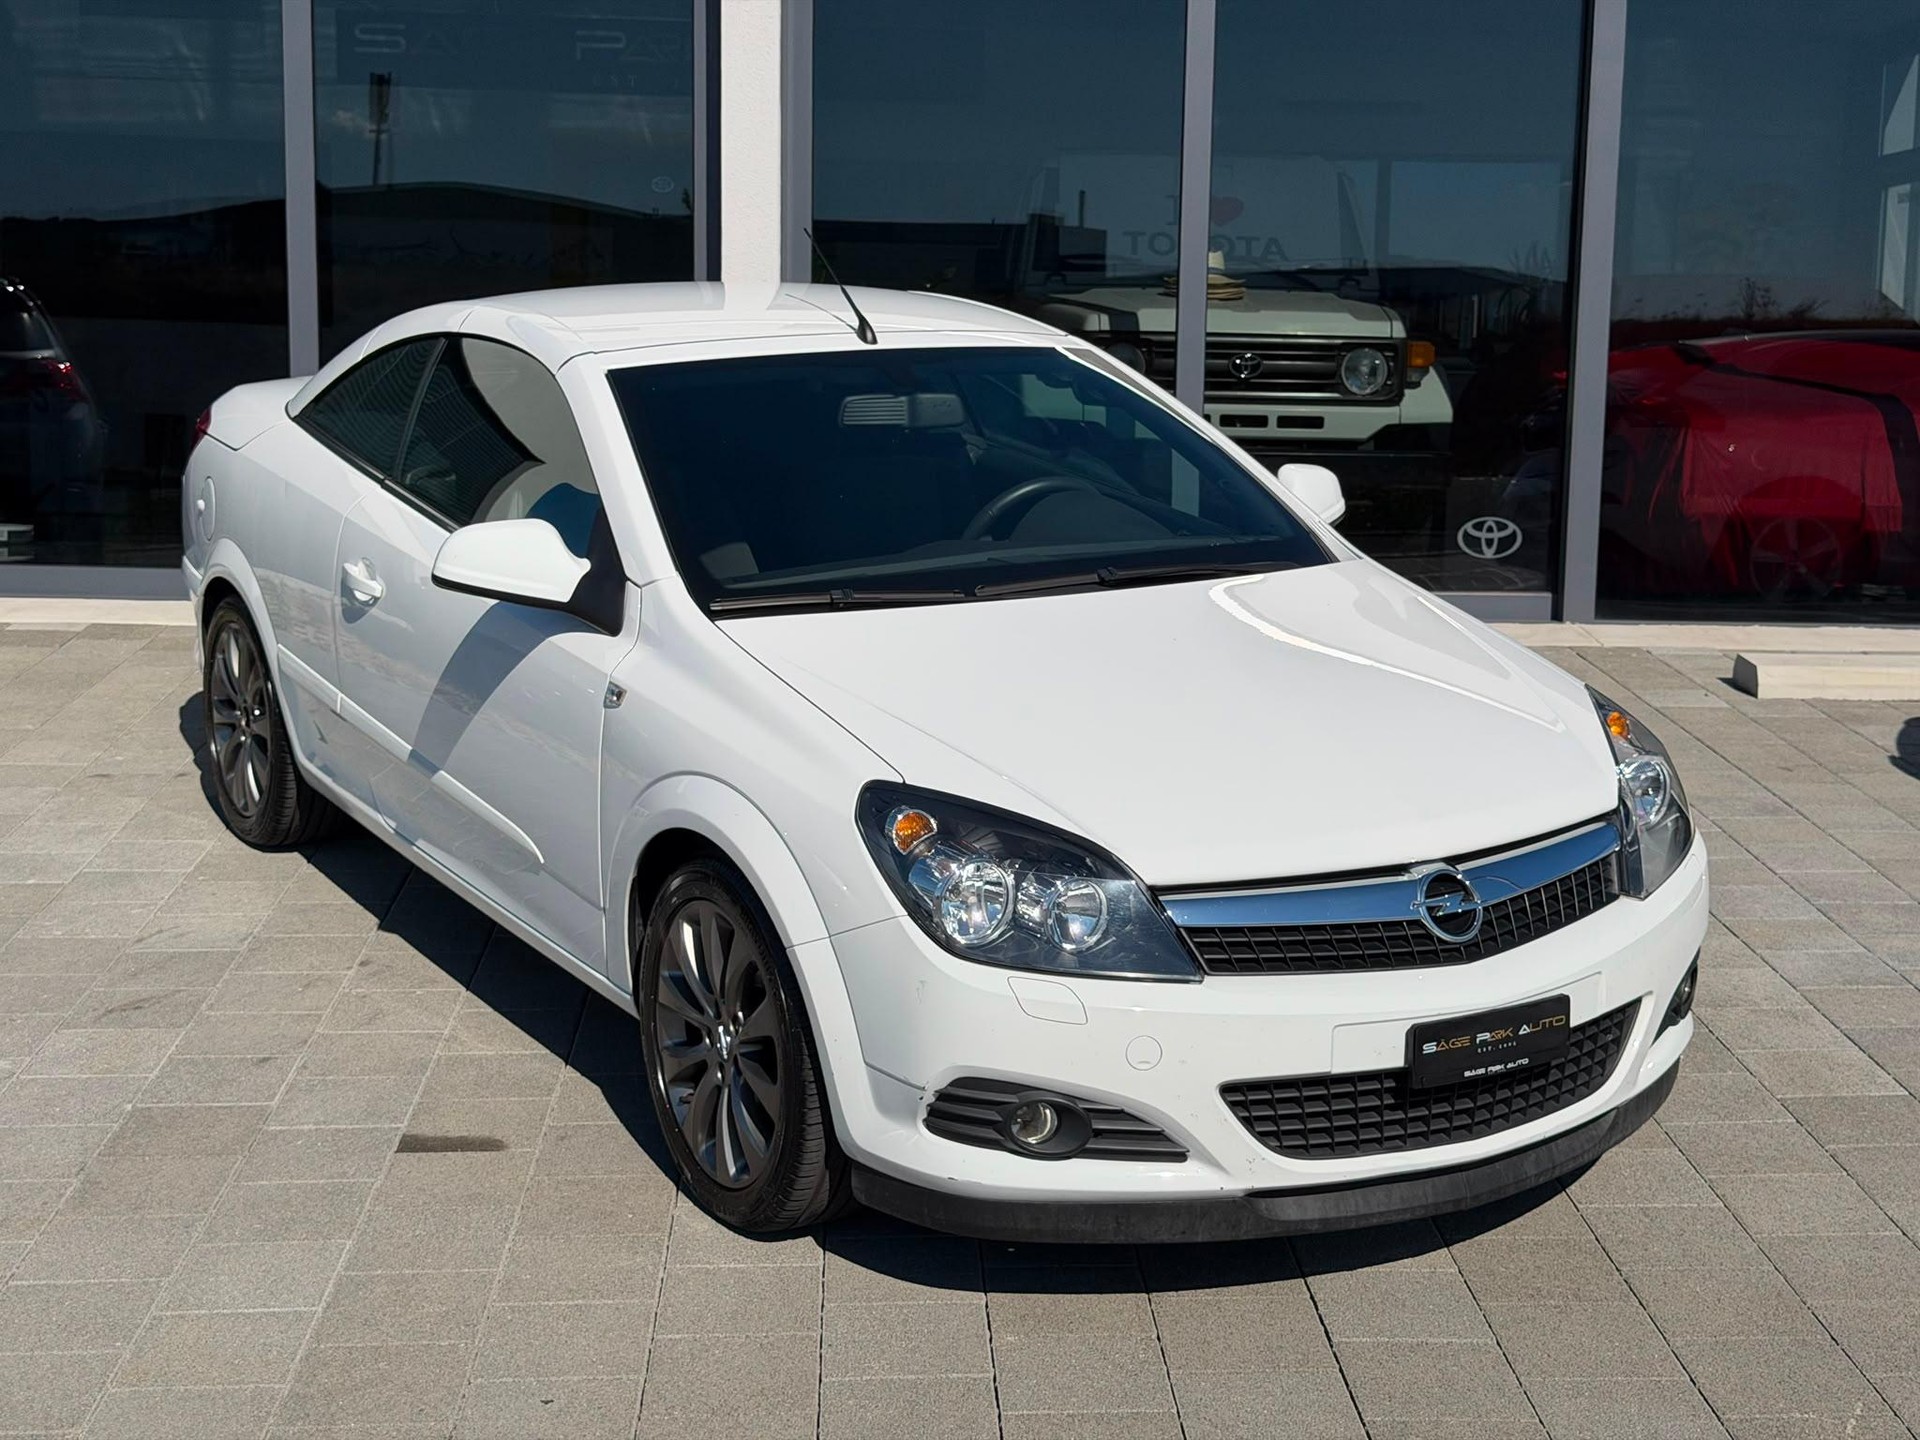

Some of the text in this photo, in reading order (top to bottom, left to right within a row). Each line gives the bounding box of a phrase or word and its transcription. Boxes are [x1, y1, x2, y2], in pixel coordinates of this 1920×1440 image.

[1122, 230, 1288, 262] TOOTA
[1422, 1015, 1566, 1054] SAGE PARK AUTO
[1506, 1057, 1529, 1068] AUTO
